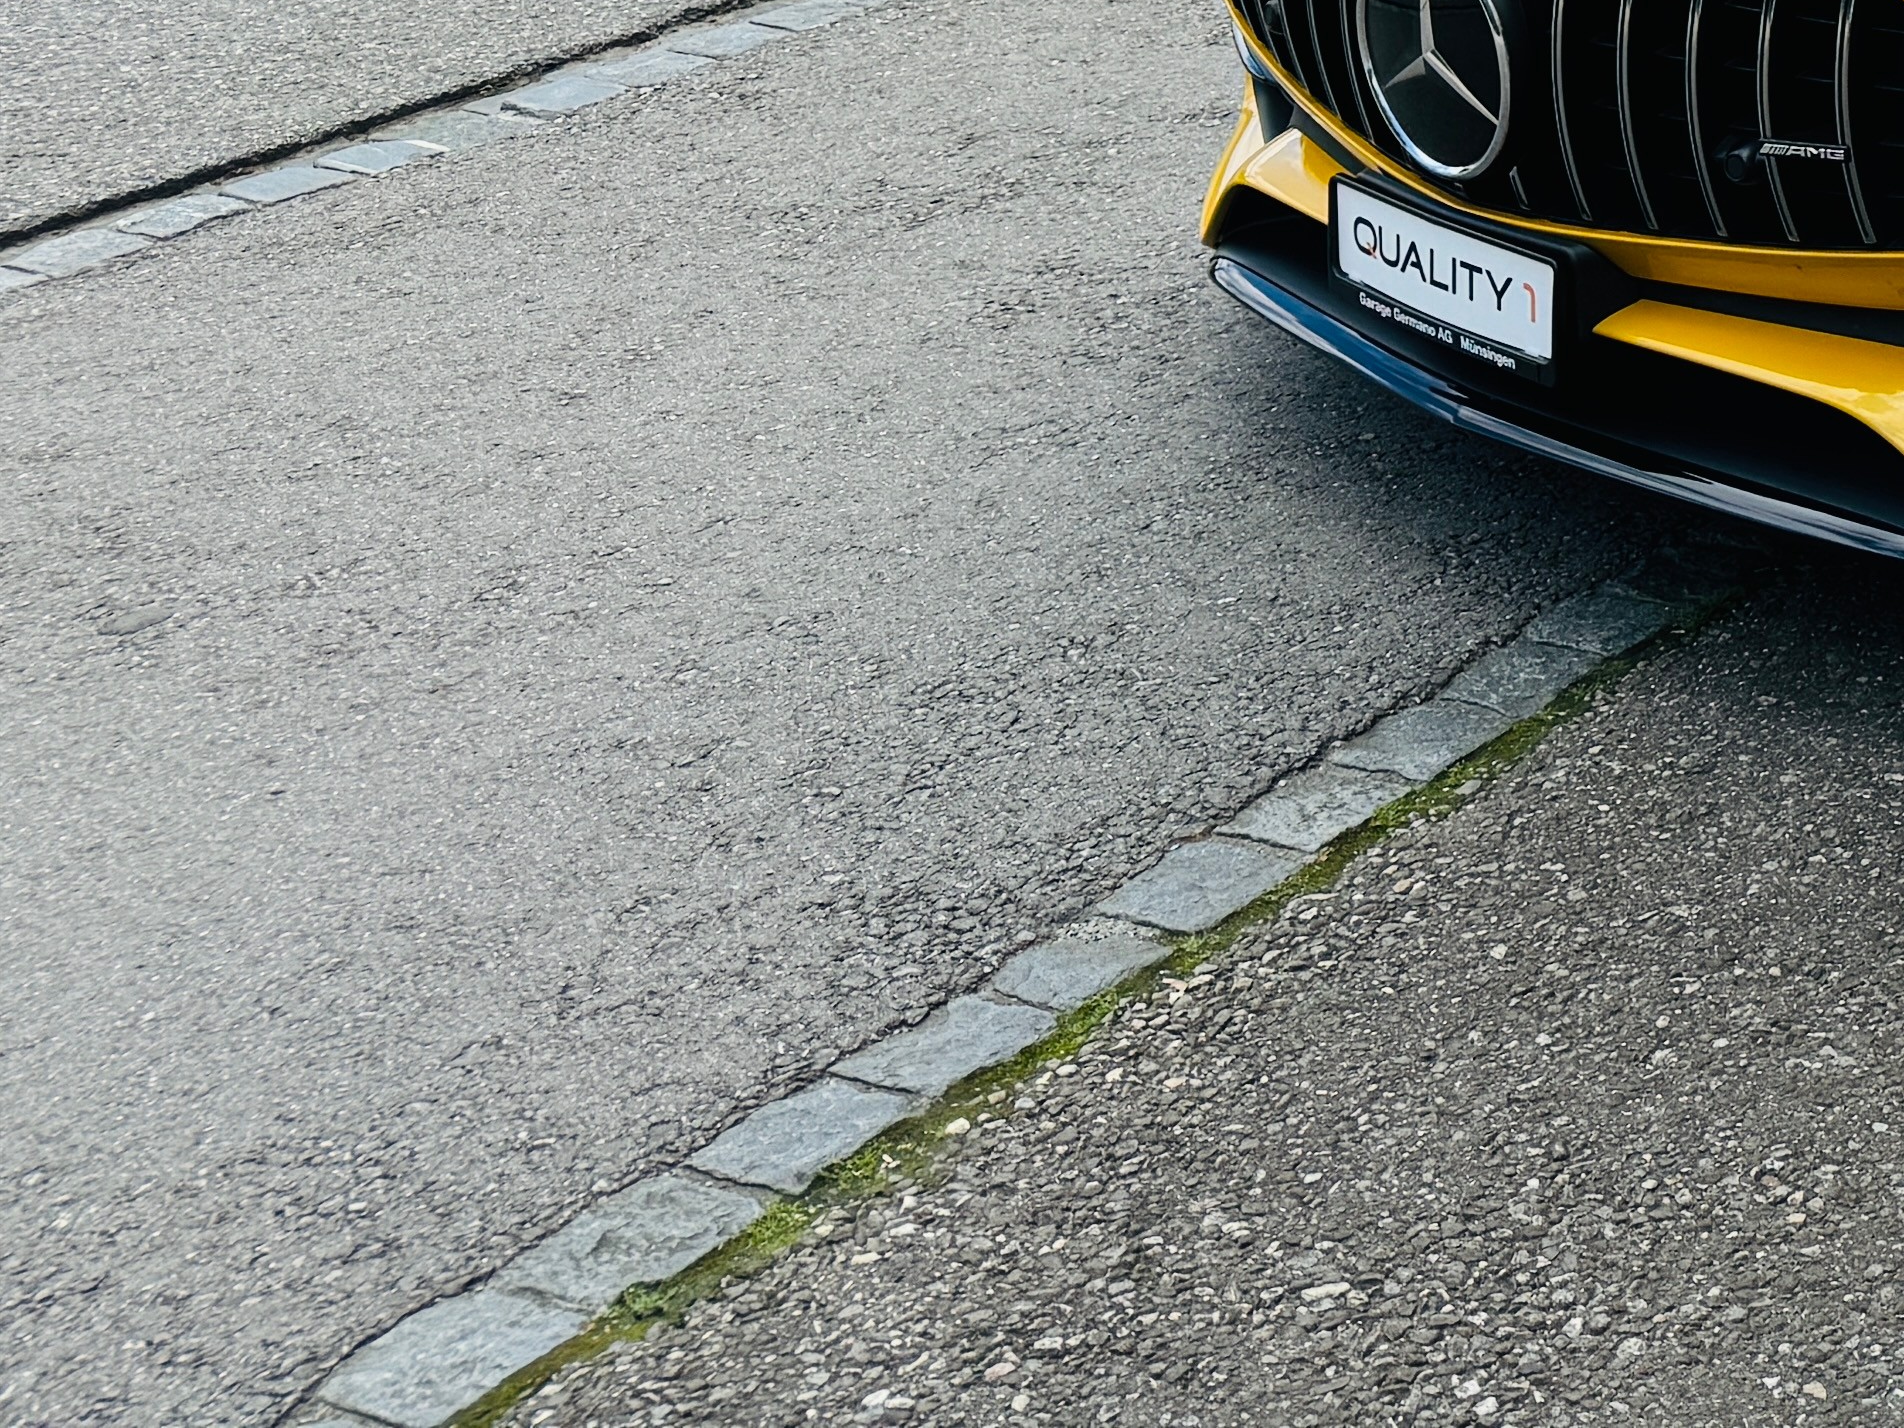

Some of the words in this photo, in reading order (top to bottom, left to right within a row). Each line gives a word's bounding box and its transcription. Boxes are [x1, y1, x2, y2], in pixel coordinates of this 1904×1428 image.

[1785, 146, 1844, 160] AMG
[1353, 216, 1512, 311] QUALITY
[1522, 281, 1537, 324] 1
[1358, 291, 1393, 319] Garage
[1392, 307, 1437, 339] Germano
[1437, 327, 1454, 345] AG
[1459, 334, 1517, 371] Münsingen
